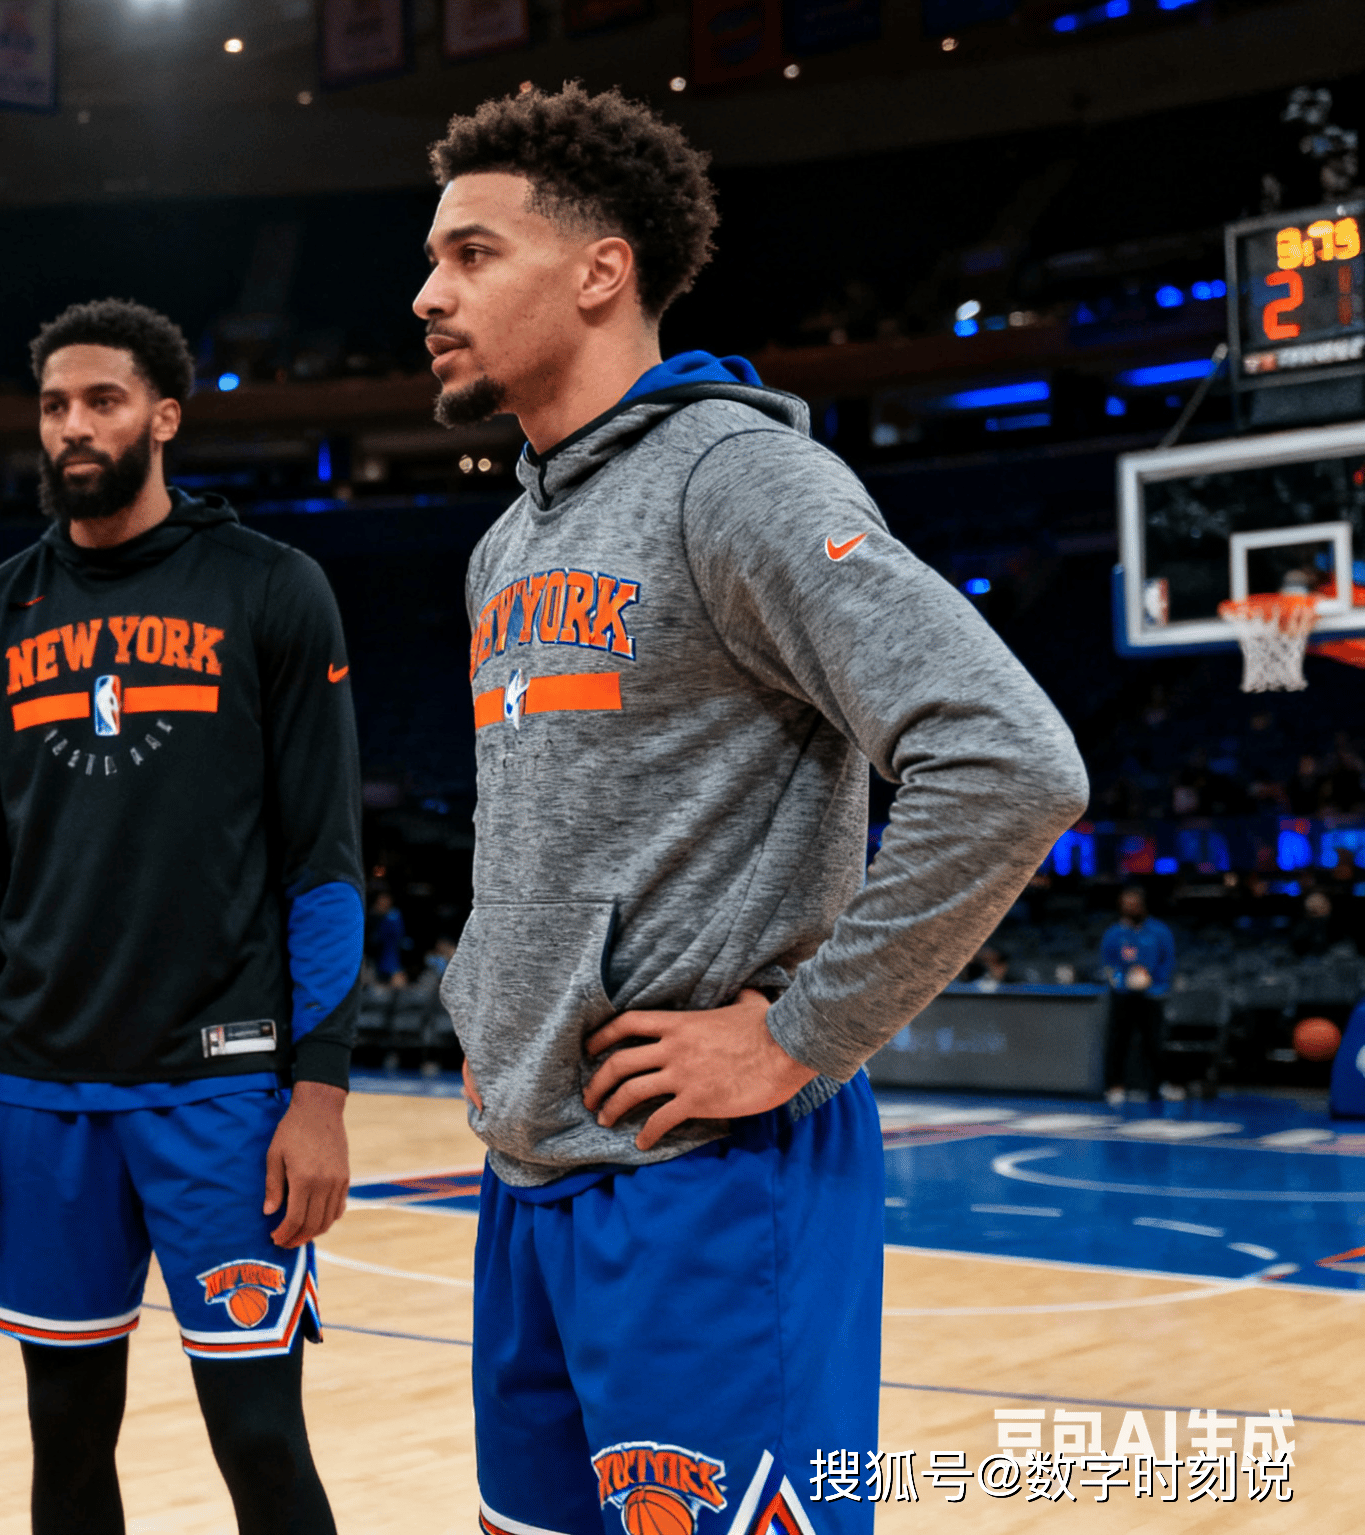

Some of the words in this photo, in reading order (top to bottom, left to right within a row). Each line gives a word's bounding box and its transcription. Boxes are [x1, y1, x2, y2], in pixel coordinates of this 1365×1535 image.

[5, 618, 103, 696] NEW
[108, 615, 225, 676] YORK
[518, 567, 641, 662] YORK
